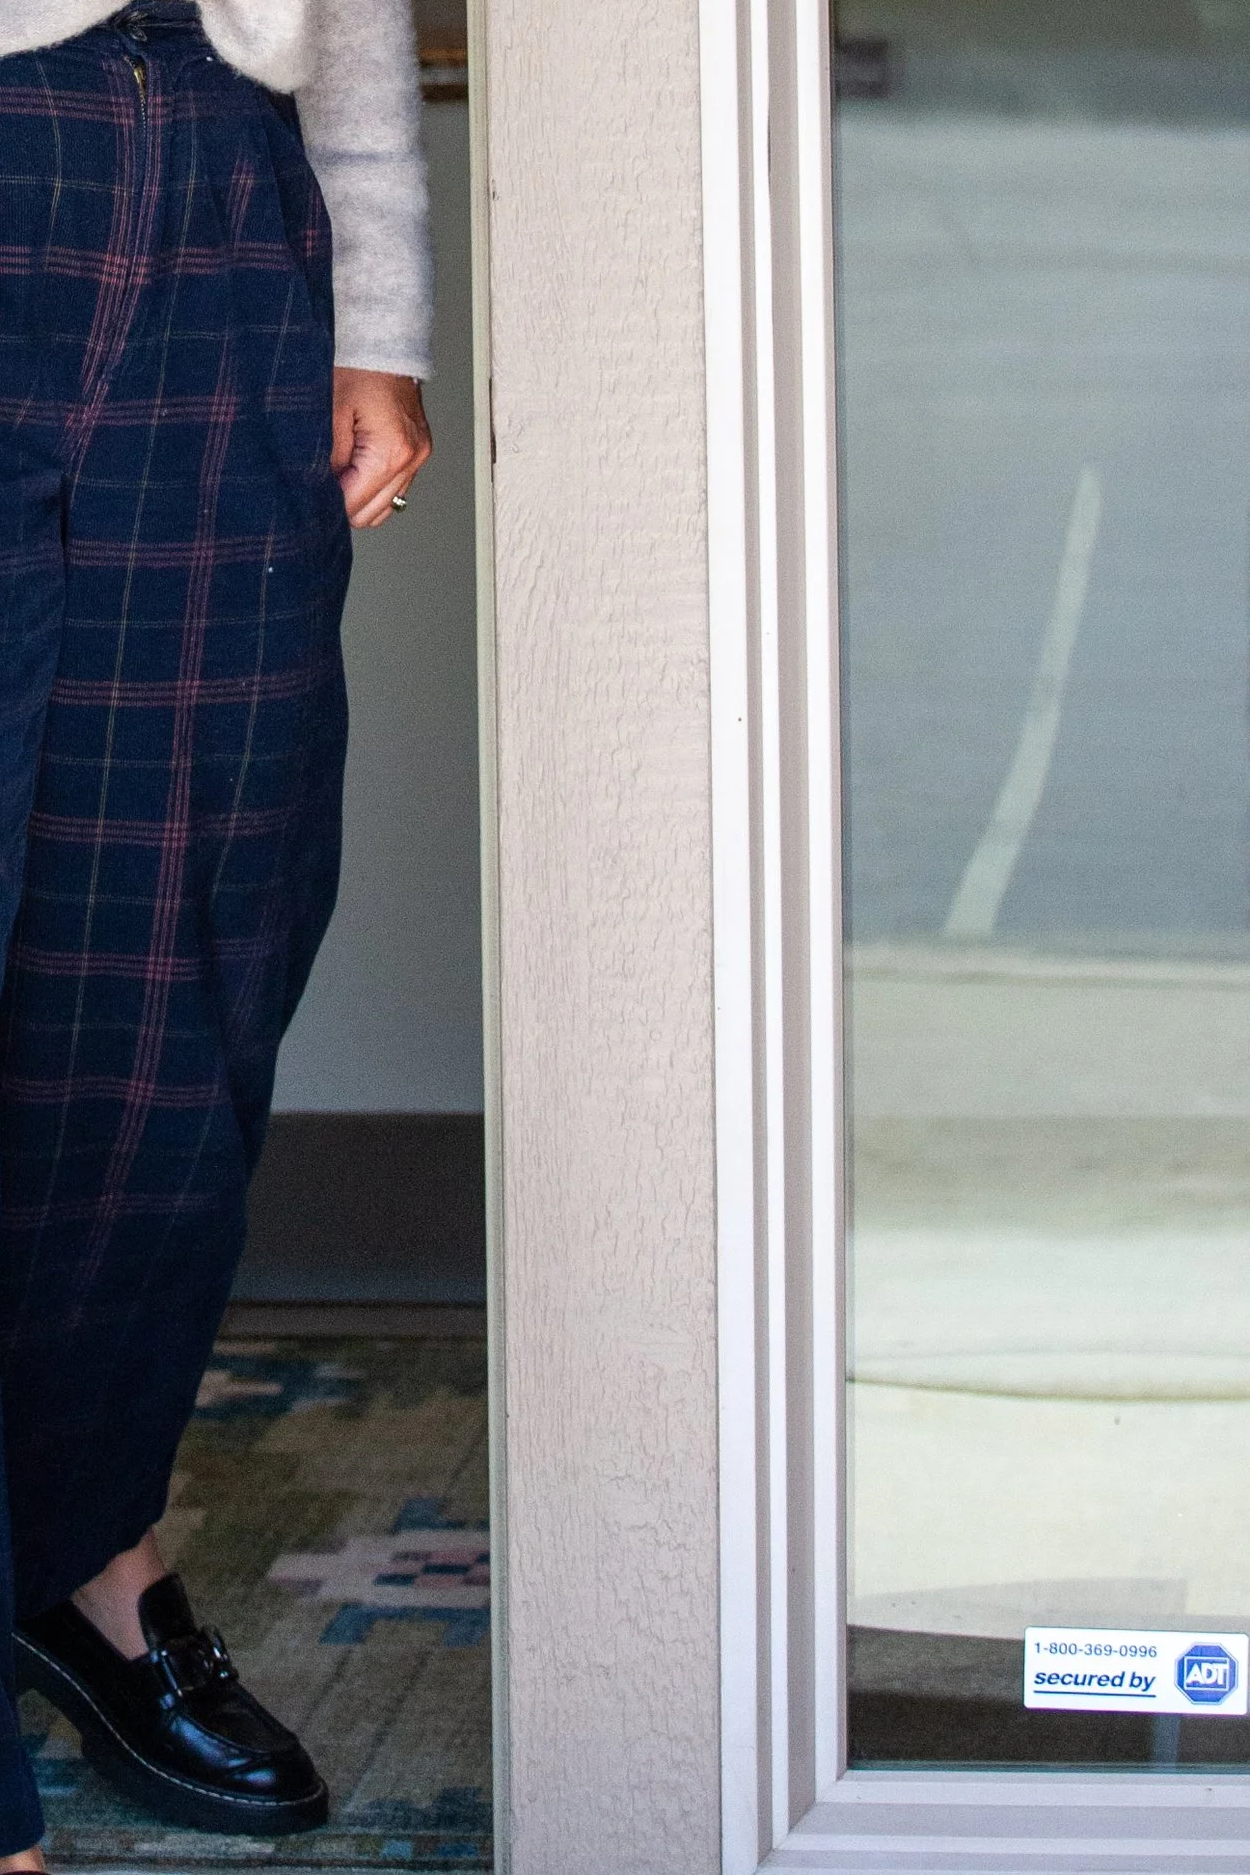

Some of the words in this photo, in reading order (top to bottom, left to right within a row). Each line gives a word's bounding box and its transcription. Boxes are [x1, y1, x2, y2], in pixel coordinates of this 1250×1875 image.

[1034, 1642, 1158, 1658] 1-800-369-0996
[1034, 1671, 1126, 1688] secured
[1129, 1672, 1156, 1692] by
[1186, 1662, 1229, 1685] ADT
